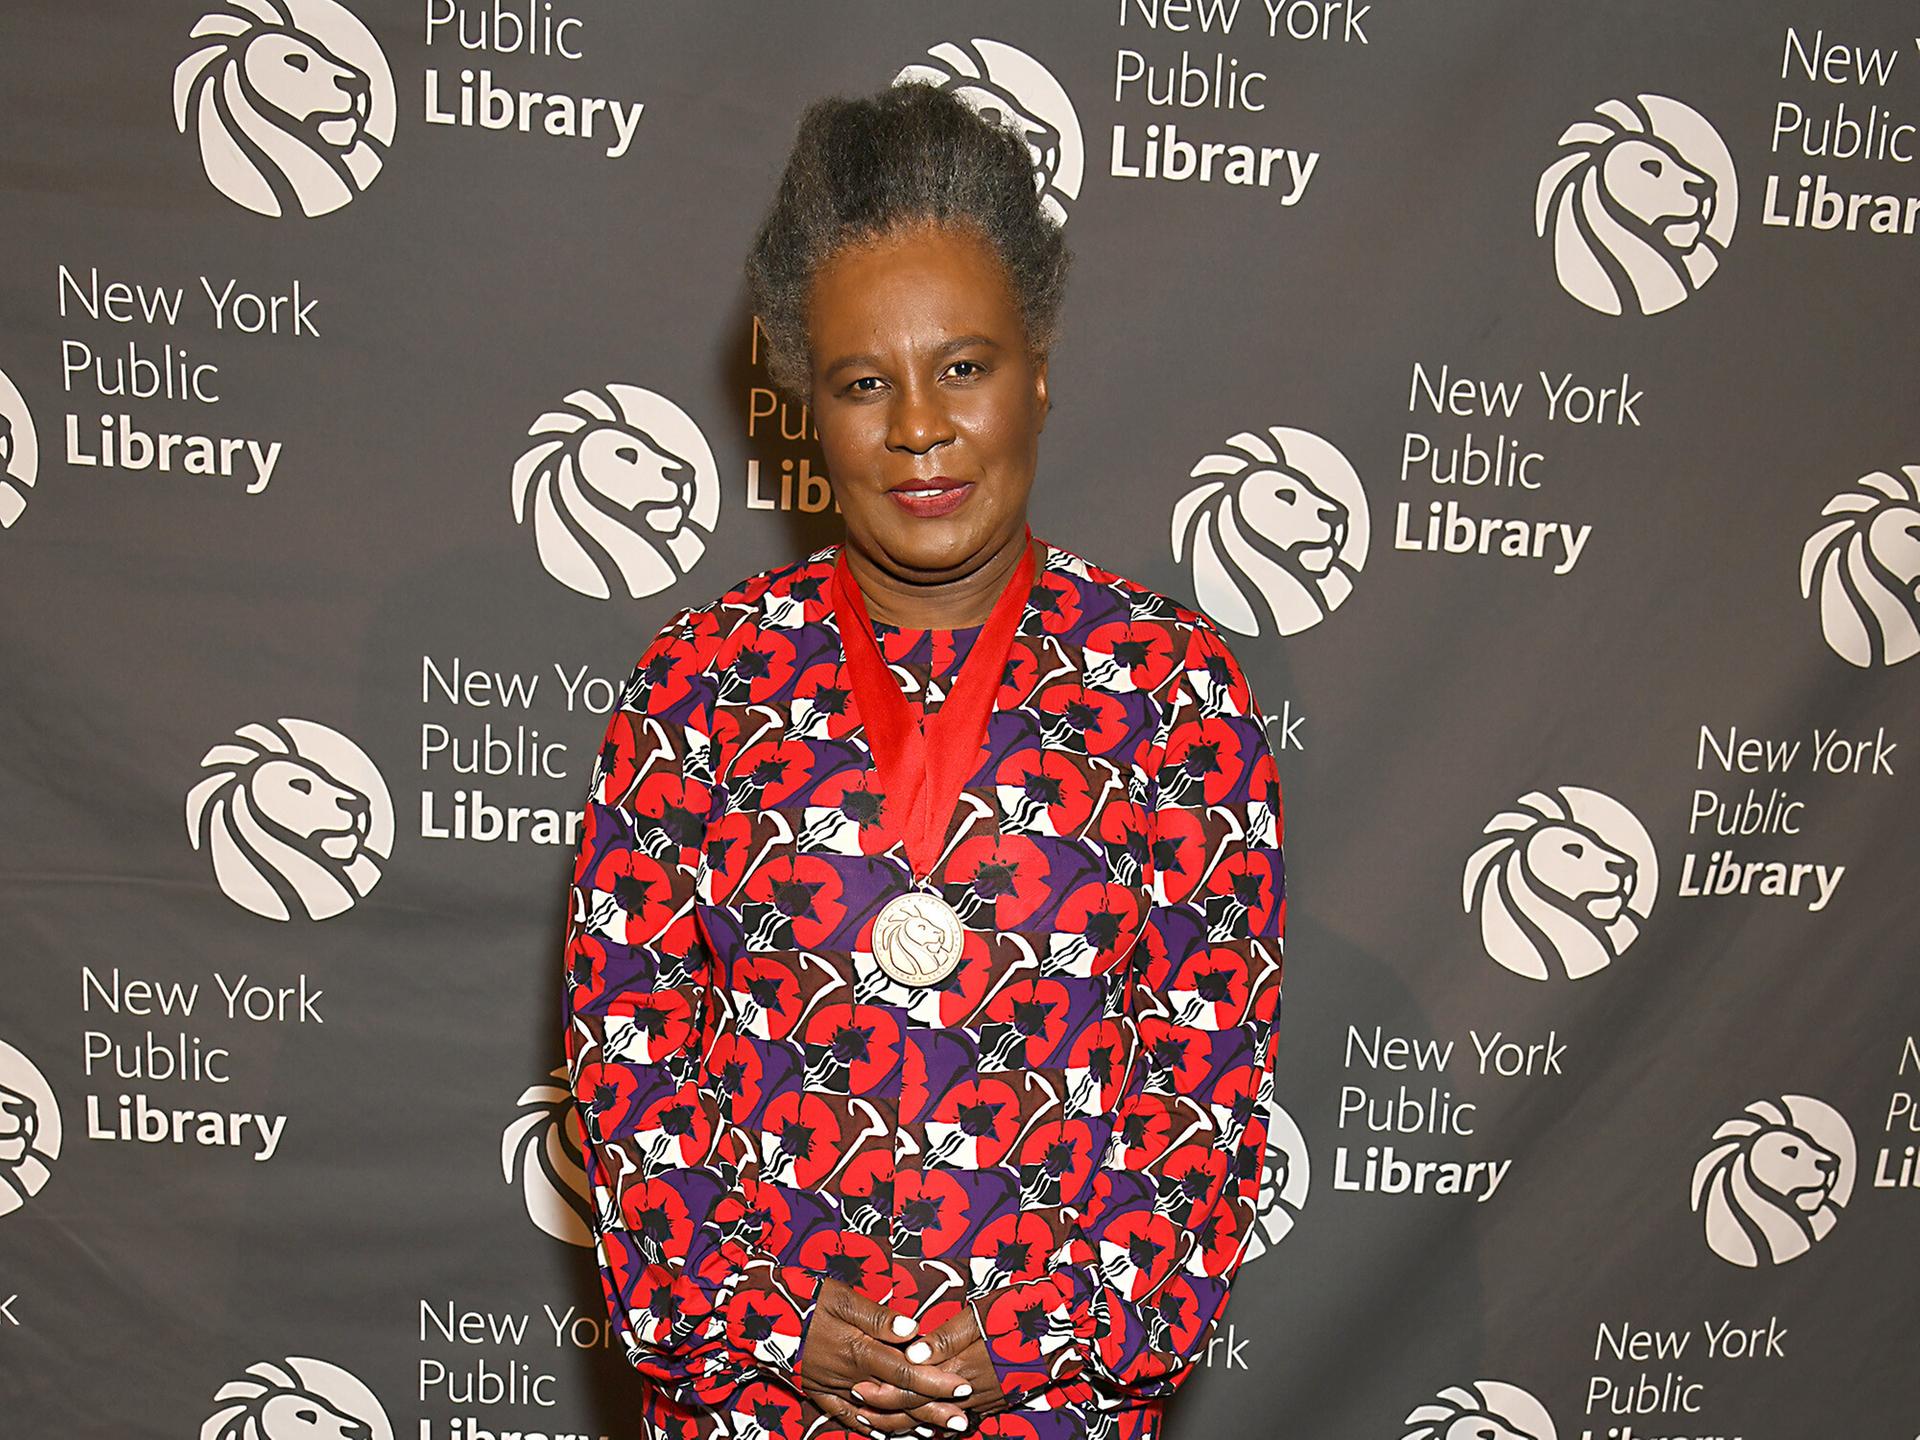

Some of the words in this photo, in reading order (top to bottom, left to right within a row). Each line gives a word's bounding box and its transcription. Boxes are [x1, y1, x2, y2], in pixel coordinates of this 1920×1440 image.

[427, 0, 583, 59] Public
[1264, 0, 1371, 44] York
[1116, 50, 1266, 111] Public
[1782, 28, 1898, 86] New
[426, 69, 644, 157] Library
[1772, 102, 1916, 162] Public
[1111, 125, 1319, 206] Library
[59, 265, 183, 325] New
[200, 276, 320, 337] York
[63, 340, 219, 402] Public
[1409, 363, 1523, 417] New
[1540, 371, 1643, 426] York
[66, 414, 282, 493] Library
[1401, 433, 1544, 489] Public
[1395, 501, 1592, 574] Library
[423, 656, 538, 708] New
[554, 663, 625, 714] Yo
[422, 724, 567, 778] Public
[1698, 725, 1800, 772] New
[1813, 727, 1897, 775] York
[1690, 788, 1804, 835] Public
[1679, 850, 1845, 911] Library
[83, 967, 198, 1016] New
[214, 973, 323, 1023] York
[85, 1031, 229, 1082] Public
[1345, 1025, 1454, 1072] New
[1470, 1030, 1567, 1075] York
[87, 1094, 287, 1160] Library
[1339, 1086, 1476, 1135] Public
[1334, 1147, 1512, 1202] Library
[421, 1300, 528, 1345] New
[1595, 1322, 1690, 1360] New
[1705, 1317, 1787, 1358] York
[420, 1359, 556, 1406] Public
[1586, 1373, 1703, 1414] Public
